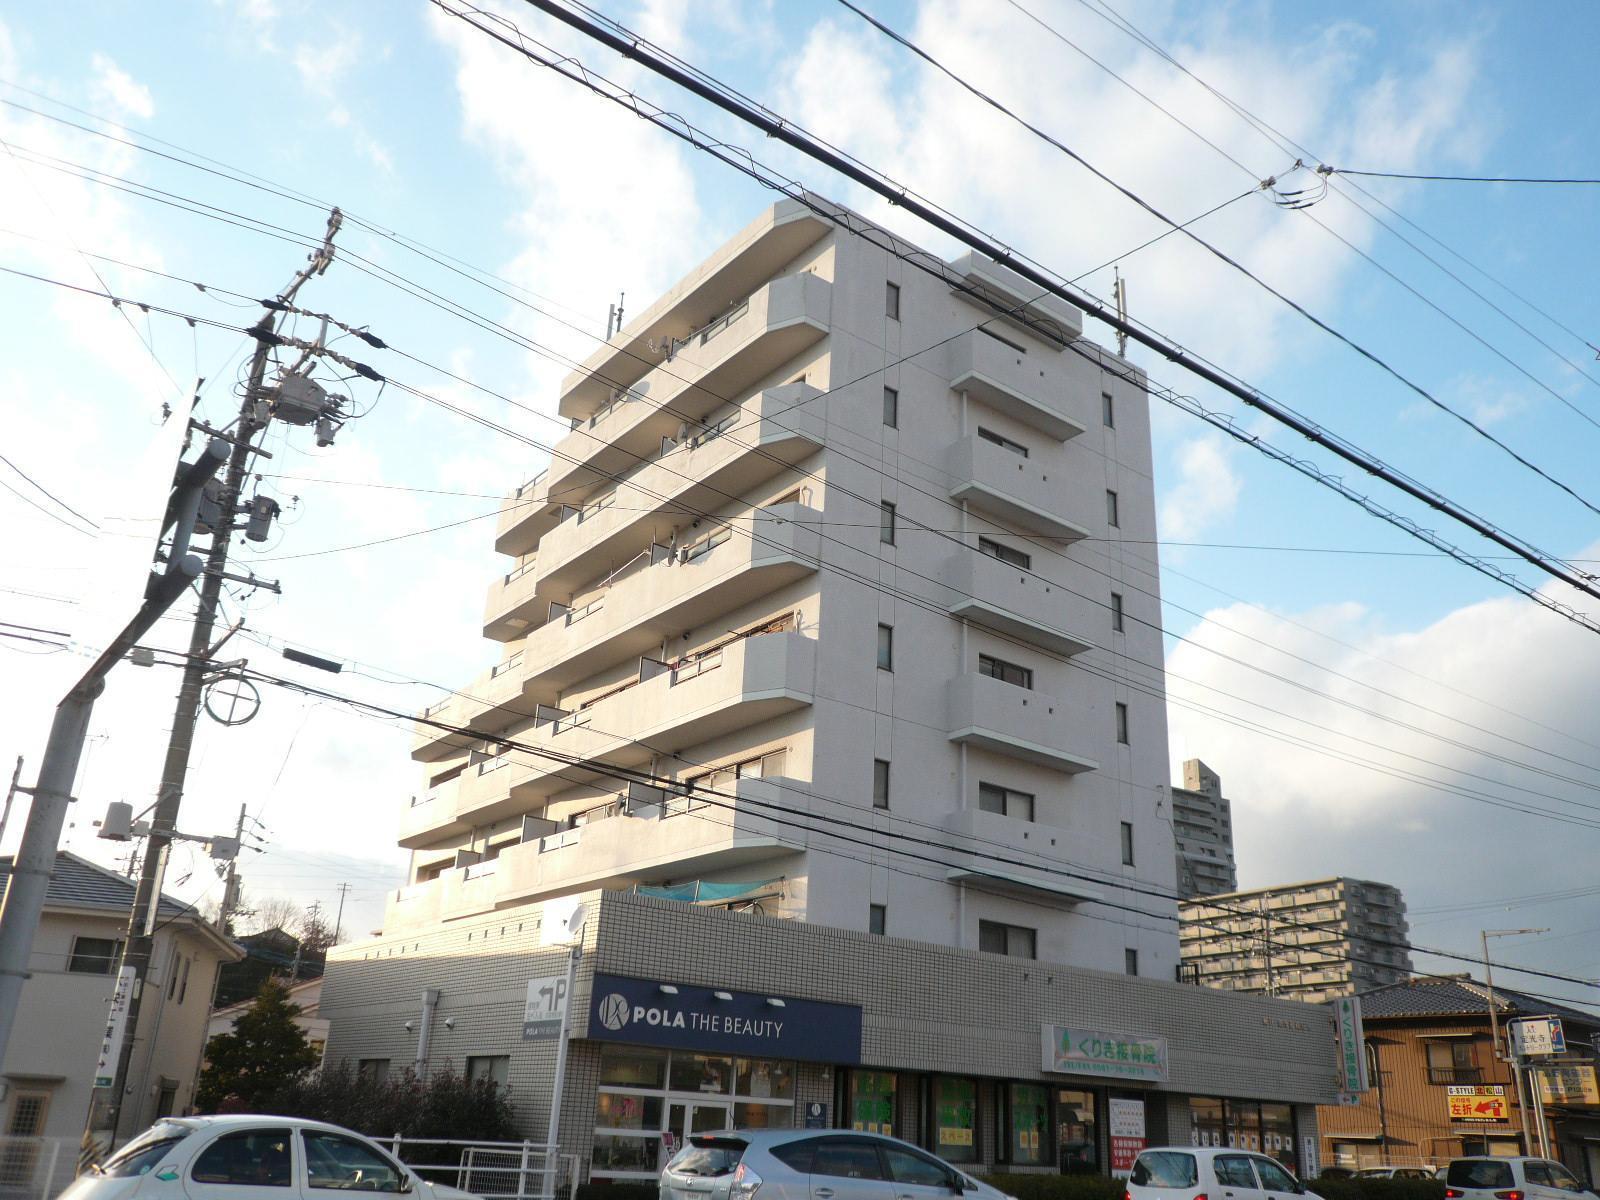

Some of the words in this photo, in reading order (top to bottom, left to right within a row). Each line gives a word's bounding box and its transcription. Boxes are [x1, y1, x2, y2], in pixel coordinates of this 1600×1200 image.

[554, 979, 567, 1011] P
[633, 1006, 685, 1029] POLA
[690, 1012, 719, 1032] THE
[724, 1016, 783, 1039] BEAUTY
[1451, 1103, 1473, 1116] 左折
